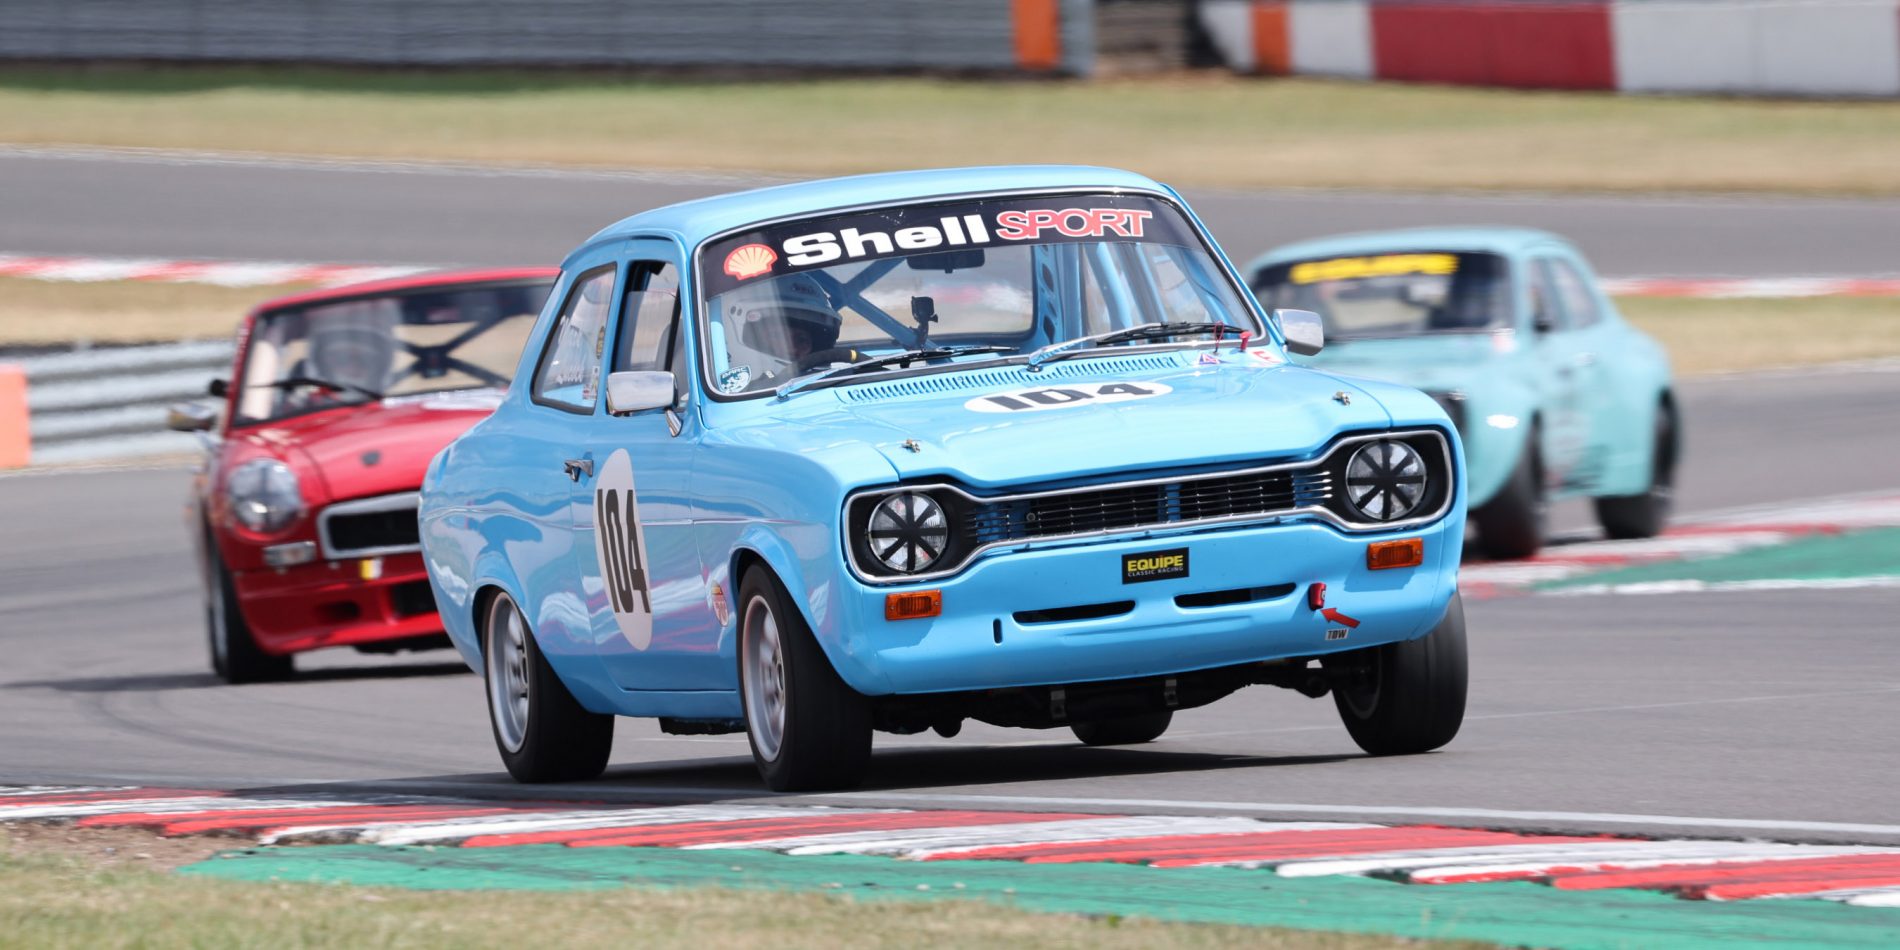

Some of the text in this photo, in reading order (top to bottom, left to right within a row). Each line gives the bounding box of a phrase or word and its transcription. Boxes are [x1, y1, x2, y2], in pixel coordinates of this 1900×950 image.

[783, 209, 1153, 266] Shell SPORT
[984, 383, 1155, 411] 104
[597, 488, 652, 614] 104
[1127, 554, 1184, 572] EQUIPE
[1127, 566, 1184, 577] CLASSIC RACING
